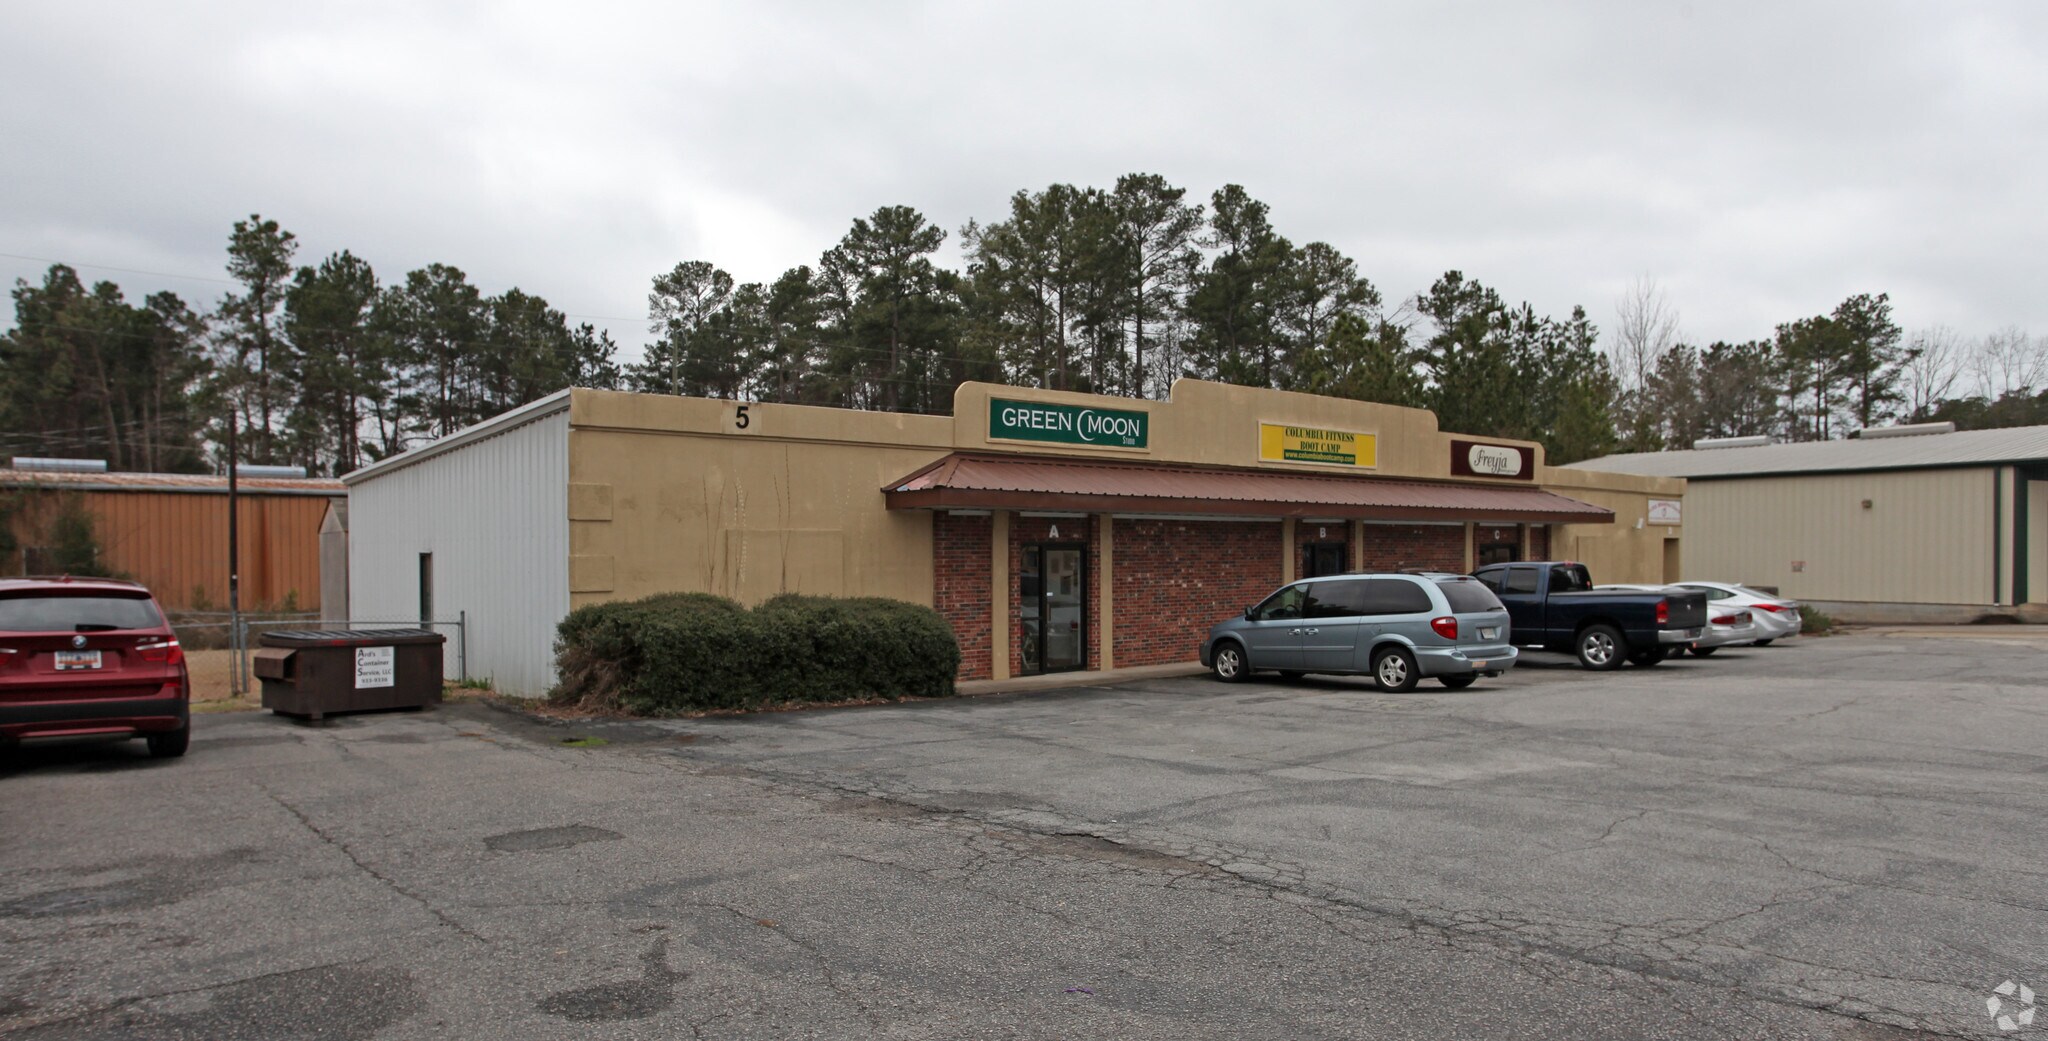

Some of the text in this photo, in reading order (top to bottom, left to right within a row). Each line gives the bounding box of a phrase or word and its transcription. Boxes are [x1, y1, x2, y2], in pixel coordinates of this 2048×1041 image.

[735, 405, 750, 430] 5
[1002, 407, 1072, 431] GREEN
[1285, 426, 1355, 443] COLUMBIA FITNESS
[1300, 440, 1341, 453] BOOT CAMP
[1473, 448, 1508, 473] Freyja
[1049, 524, 1059, 538] A
[1319, 527, 1327, 539] B
[1494, 529, 1500, 541] C
[357, 658, 389, 667] Container
